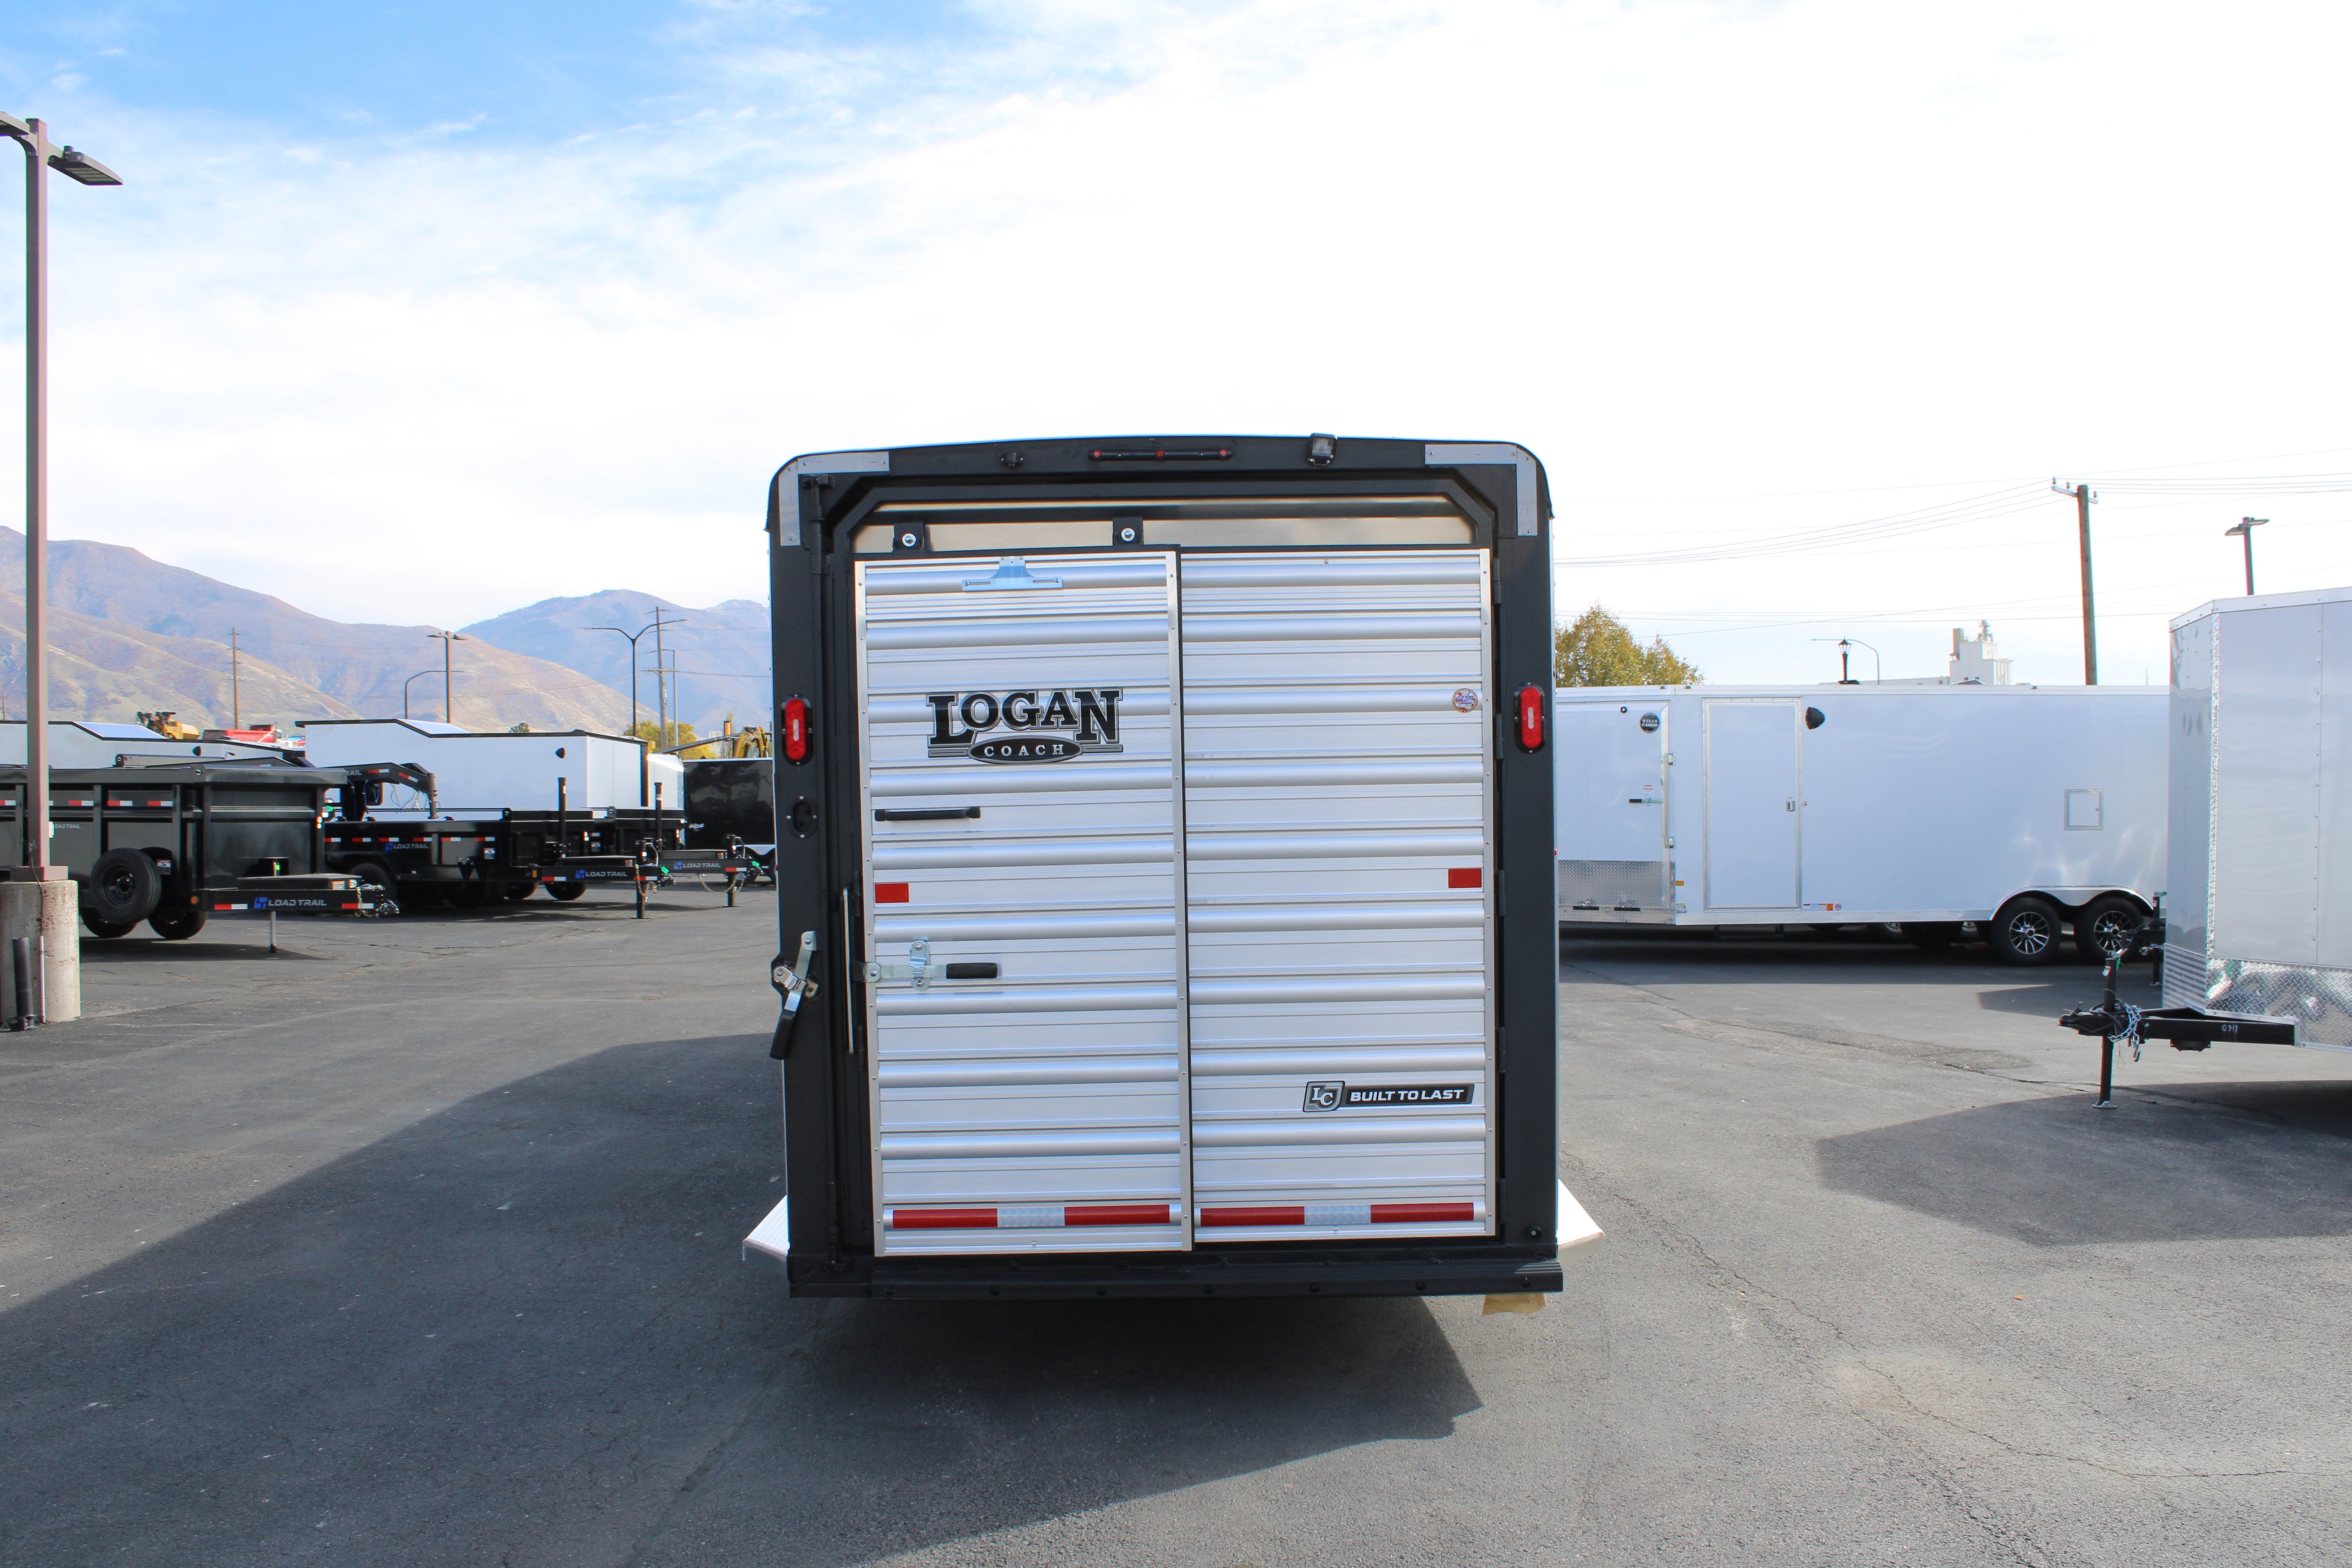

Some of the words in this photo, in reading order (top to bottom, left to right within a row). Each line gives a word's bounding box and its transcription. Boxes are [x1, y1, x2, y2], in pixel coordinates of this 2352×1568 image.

[926, 688, 1123, 748] LOGAN
[984, 744, 1064, 757] COACH
[1312, 1087, 1333, 1105] LC
[1350, 1091, 1395, 1102] BUILT
[1397, 1090, 1419, 1100] TO
[1421, 1089, 1464, 1100] LAST
